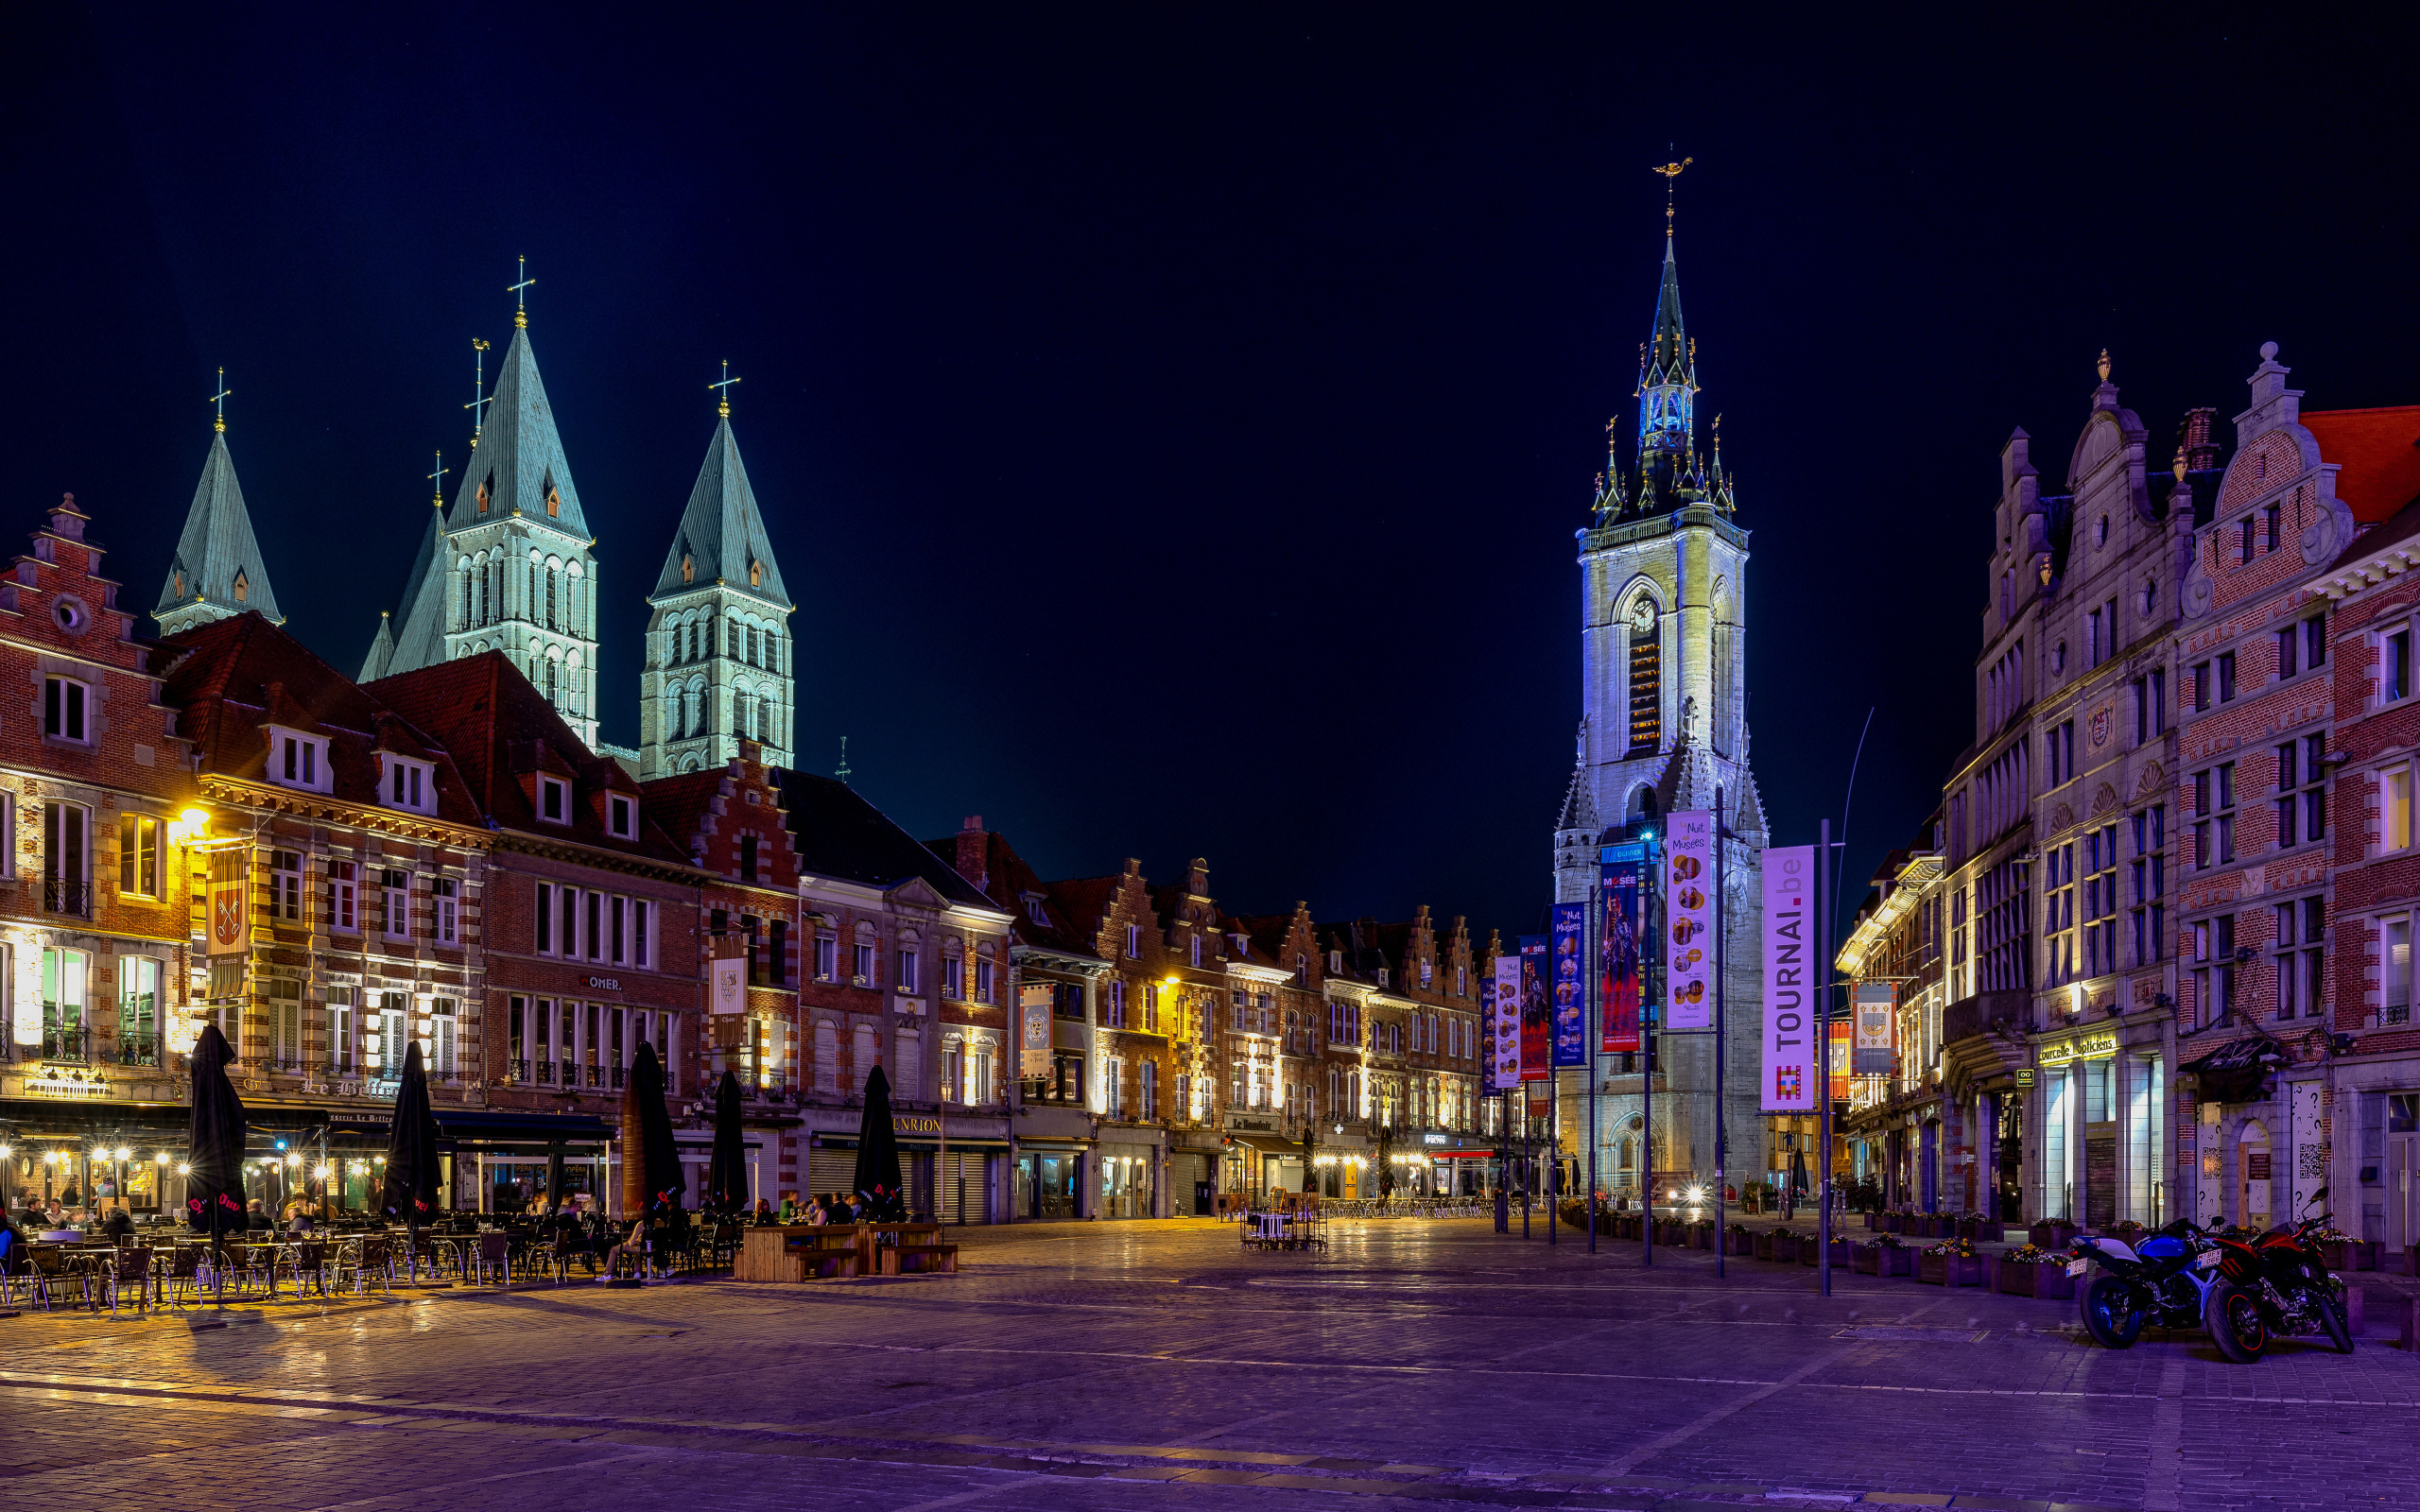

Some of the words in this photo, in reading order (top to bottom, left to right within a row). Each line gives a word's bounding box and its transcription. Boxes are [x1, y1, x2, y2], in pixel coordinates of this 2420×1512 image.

[1687, 822, 1705, 833] Nuit
[1672, 838, 1705, 850] Musées
[1617, 849, 1642, 858] OLIVIER
[1566, 910, 1582, 919] Nuit
[1556, 922, 1581, 933] Musées
[300, 1077, 330, 1094] Le
[337, 1080, 399, 1100] Beffro
[892, 1117, 942, 1132] ENRION
